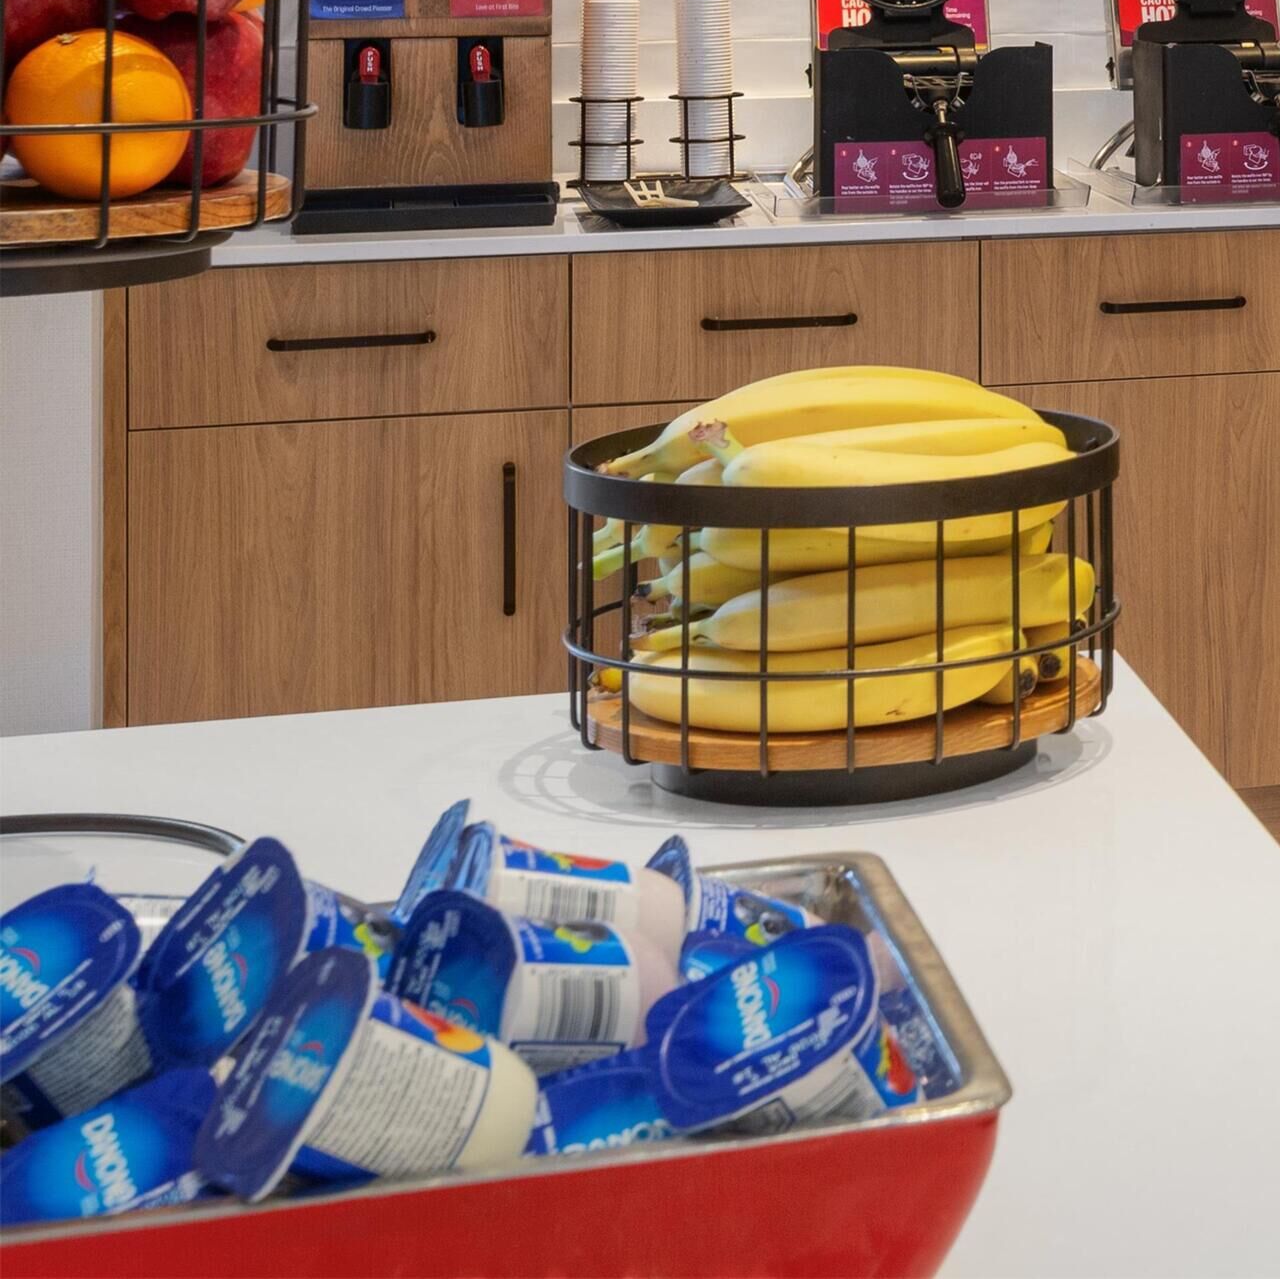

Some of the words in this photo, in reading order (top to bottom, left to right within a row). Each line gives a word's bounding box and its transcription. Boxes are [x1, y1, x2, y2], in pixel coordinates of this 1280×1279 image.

[842, 8, 872, 28] HO
[366, 50, 374, 72] PUSH
[476, 50, 484, 71] PUSH
